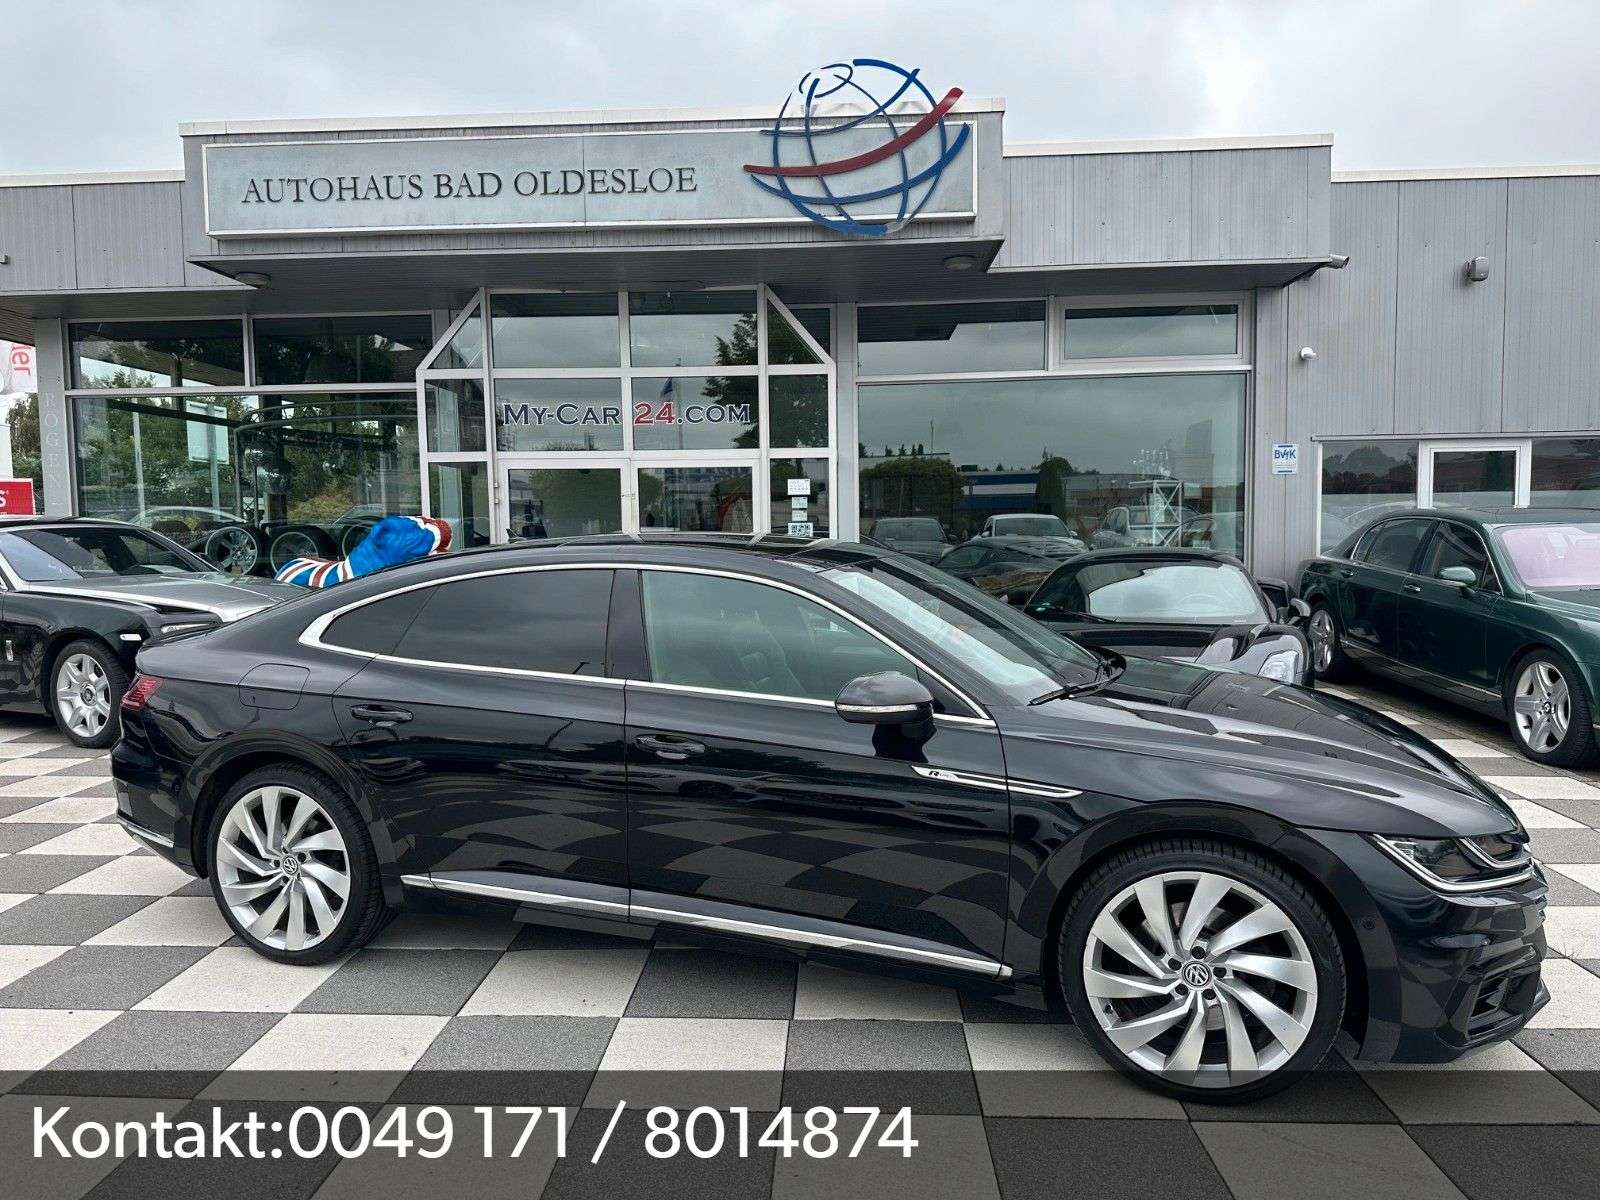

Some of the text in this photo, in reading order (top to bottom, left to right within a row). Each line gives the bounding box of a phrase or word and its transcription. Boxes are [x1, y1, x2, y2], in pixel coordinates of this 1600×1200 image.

[241, 166, 698, 203] AUTOHAUS BAD OLDESLOE
